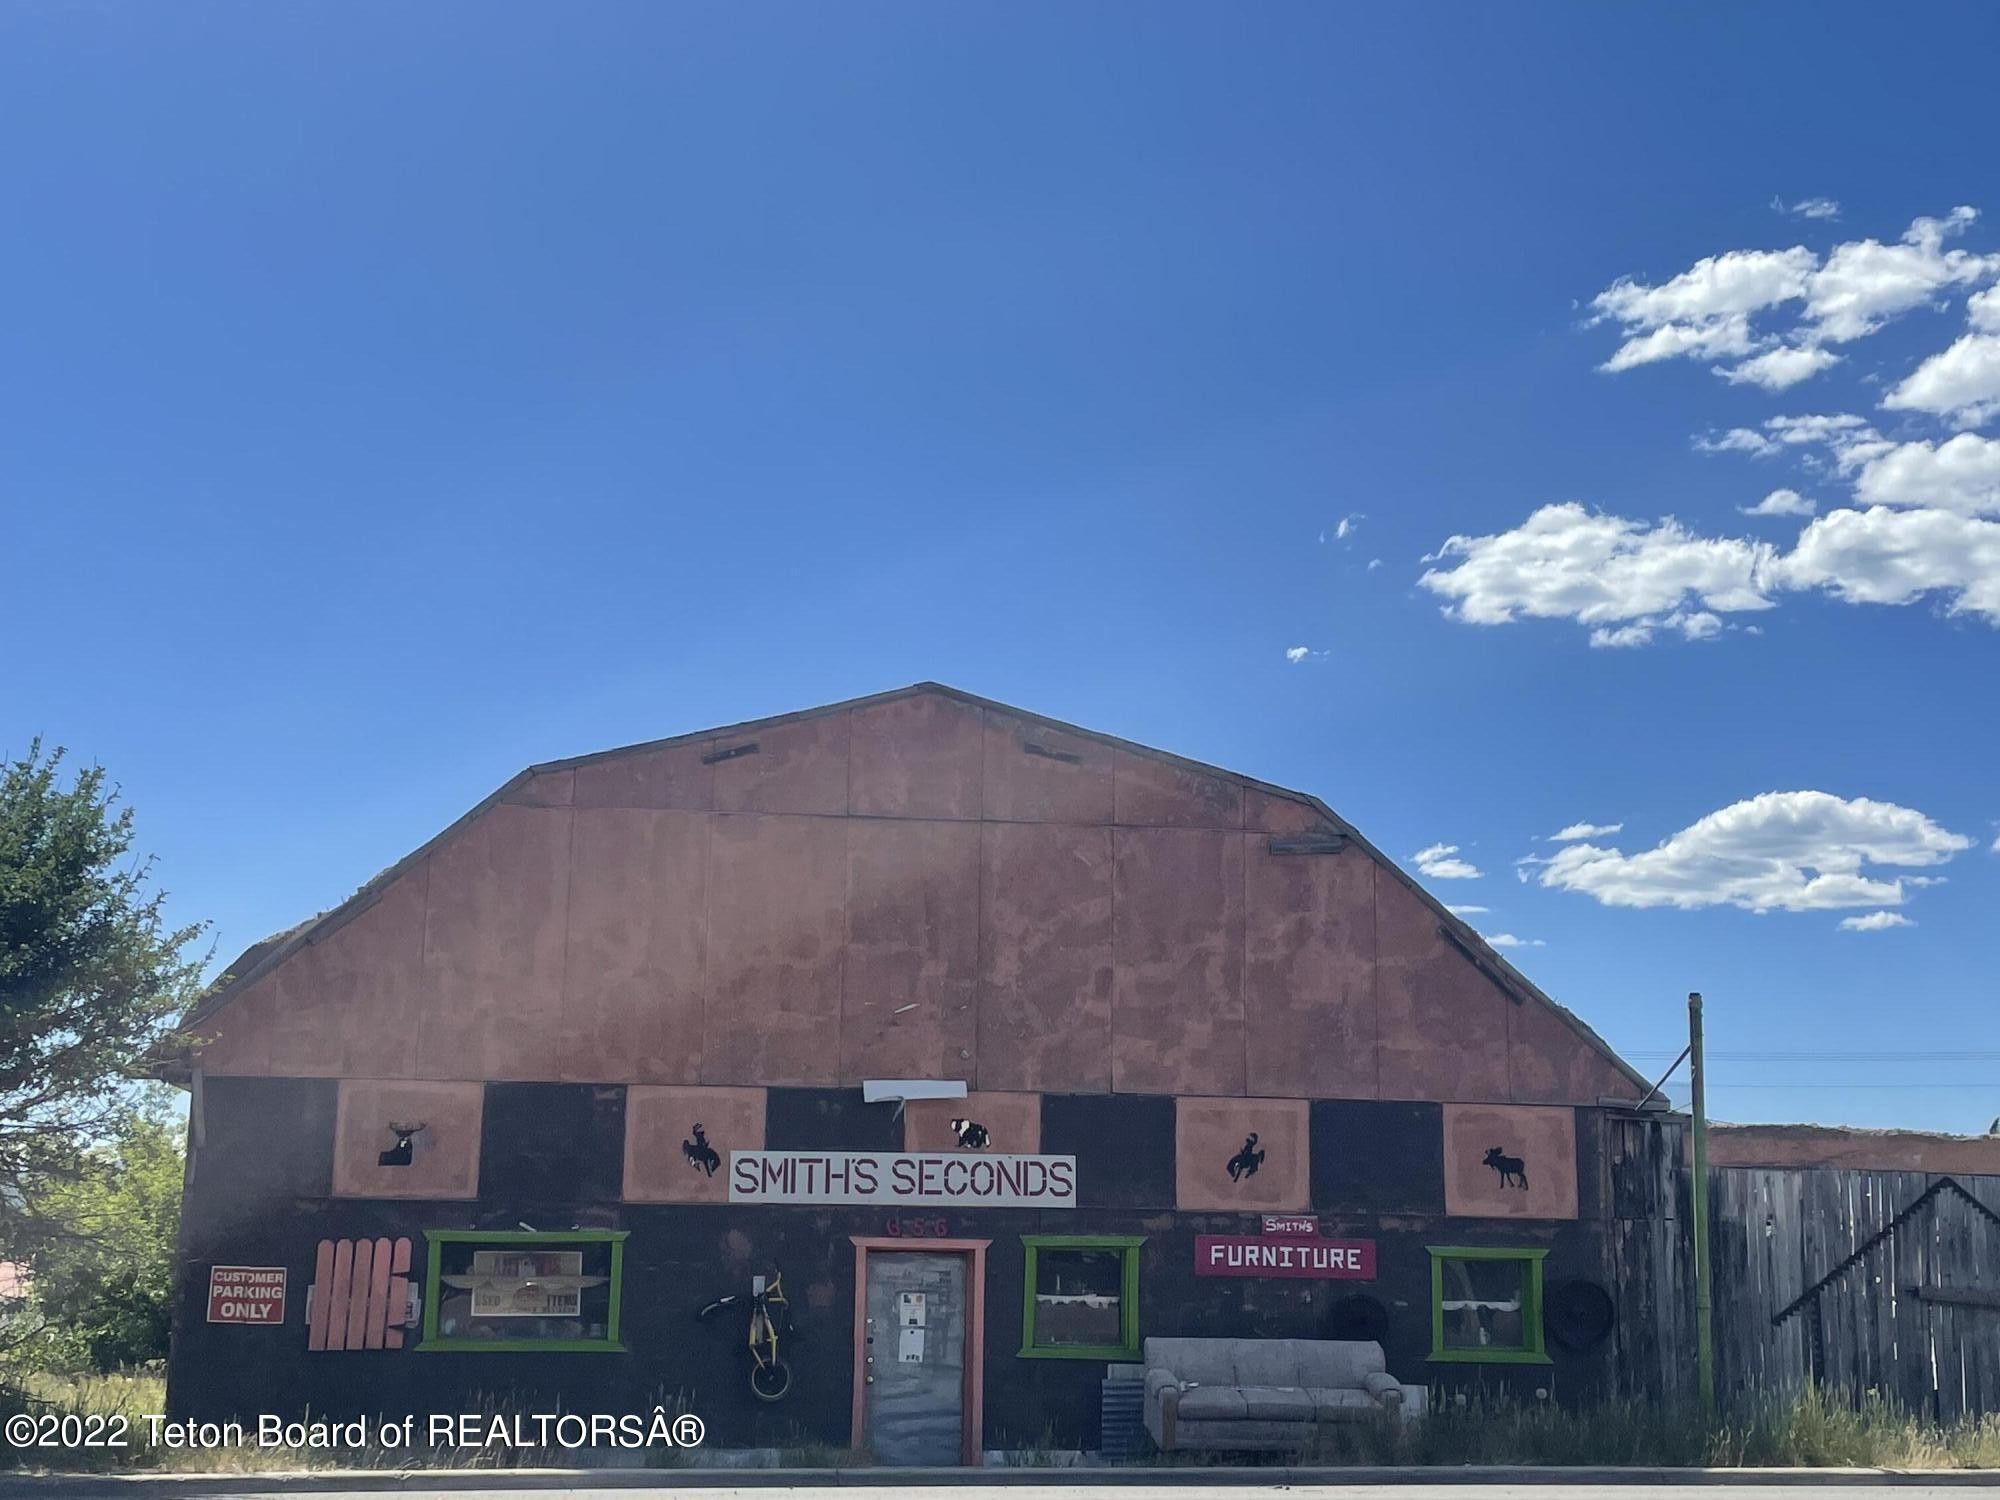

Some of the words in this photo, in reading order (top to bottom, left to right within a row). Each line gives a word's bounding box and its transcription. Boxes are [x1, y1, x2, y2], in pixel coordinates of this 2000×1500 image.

[734, 1157, 879, 1195] SMITH'S
[891, 1158, 1074, 1197] SECONDS
[1210, 1245, 1362, 1270] FURNITURE
[214, 1271, 284, 1283] CUSTOMER
[213, 1285, 283, 1299] PARKING
[220, 1301, 273, 1319] ONLY
